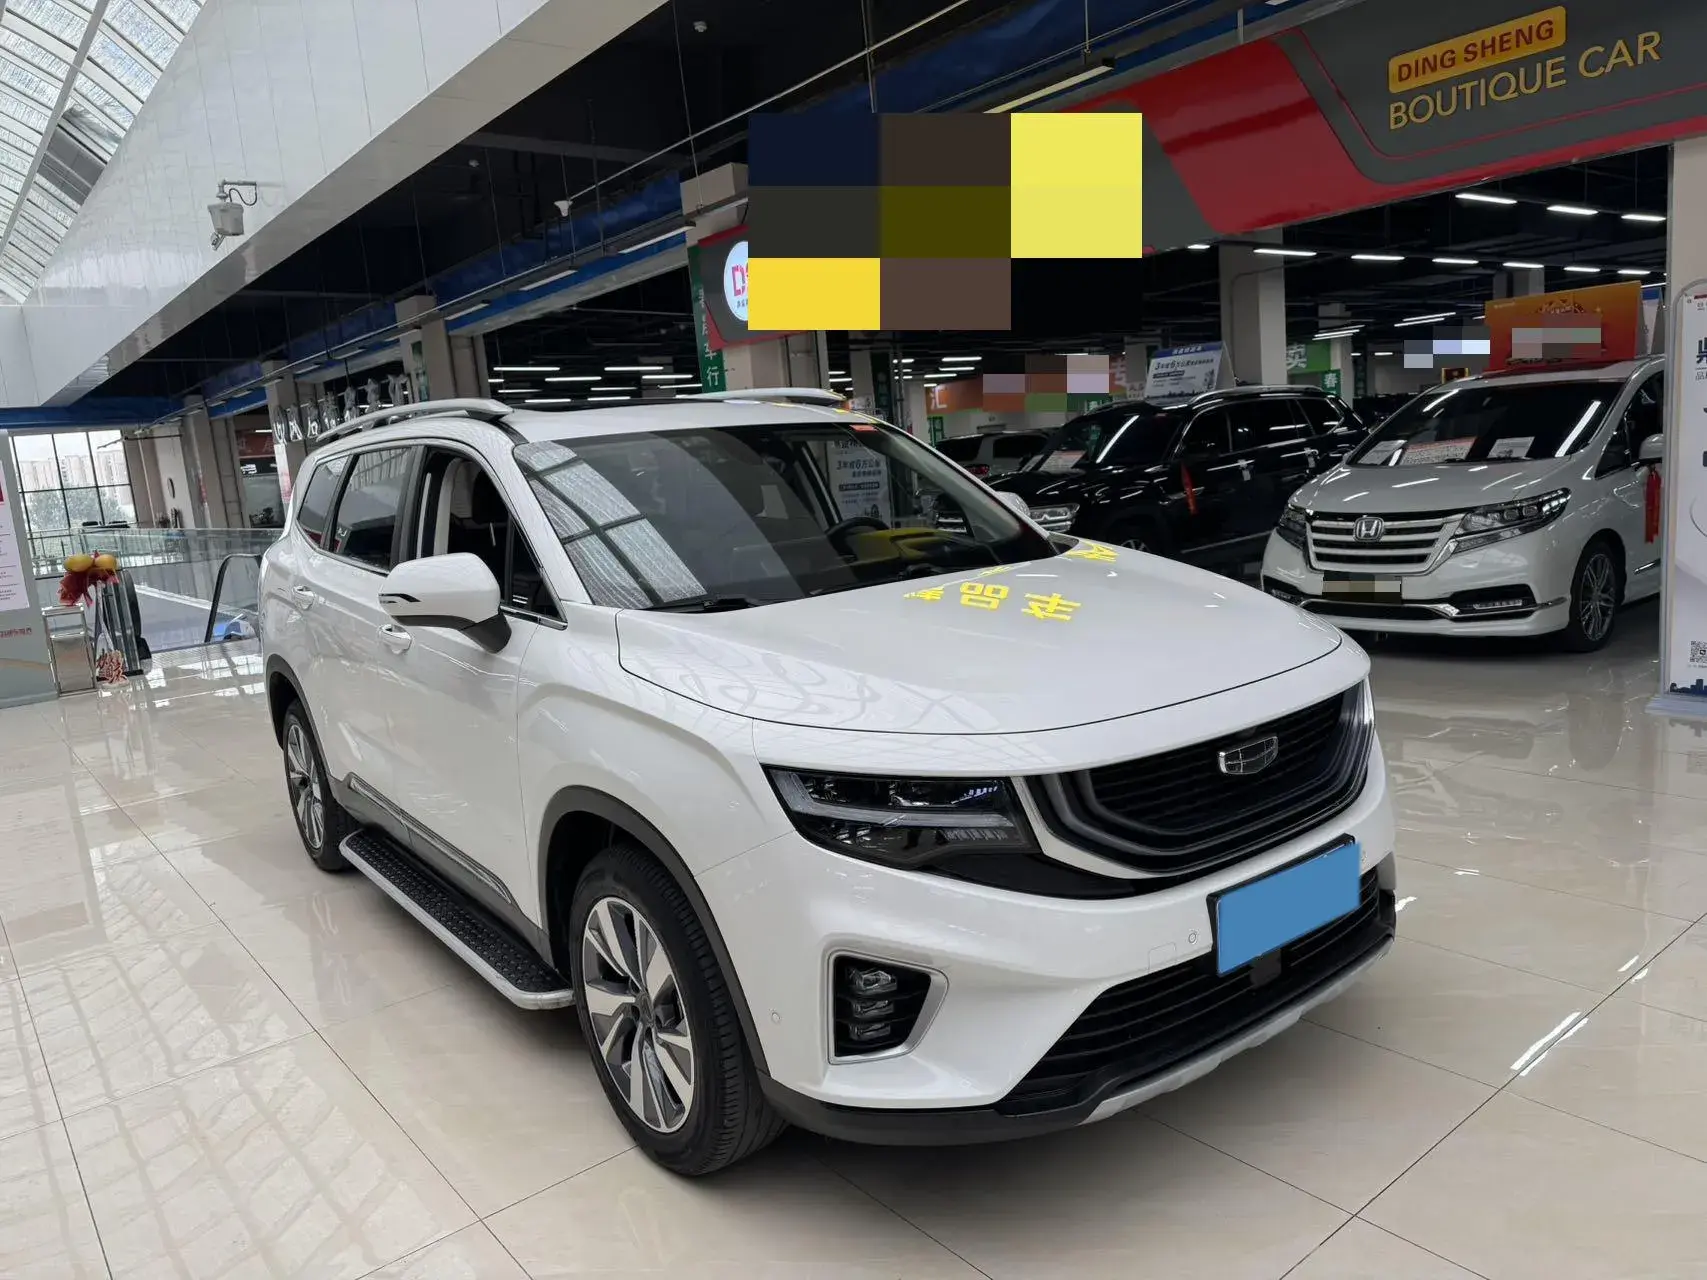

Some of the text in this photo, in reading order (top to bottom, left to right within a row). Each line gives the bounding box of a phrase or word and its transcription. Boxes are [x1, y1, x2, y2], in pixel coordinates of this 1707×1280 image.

[1389, 31, 1662, 130] BOUTIQUE CAR
[1397, 19, 1555, 83] DING SHENG
